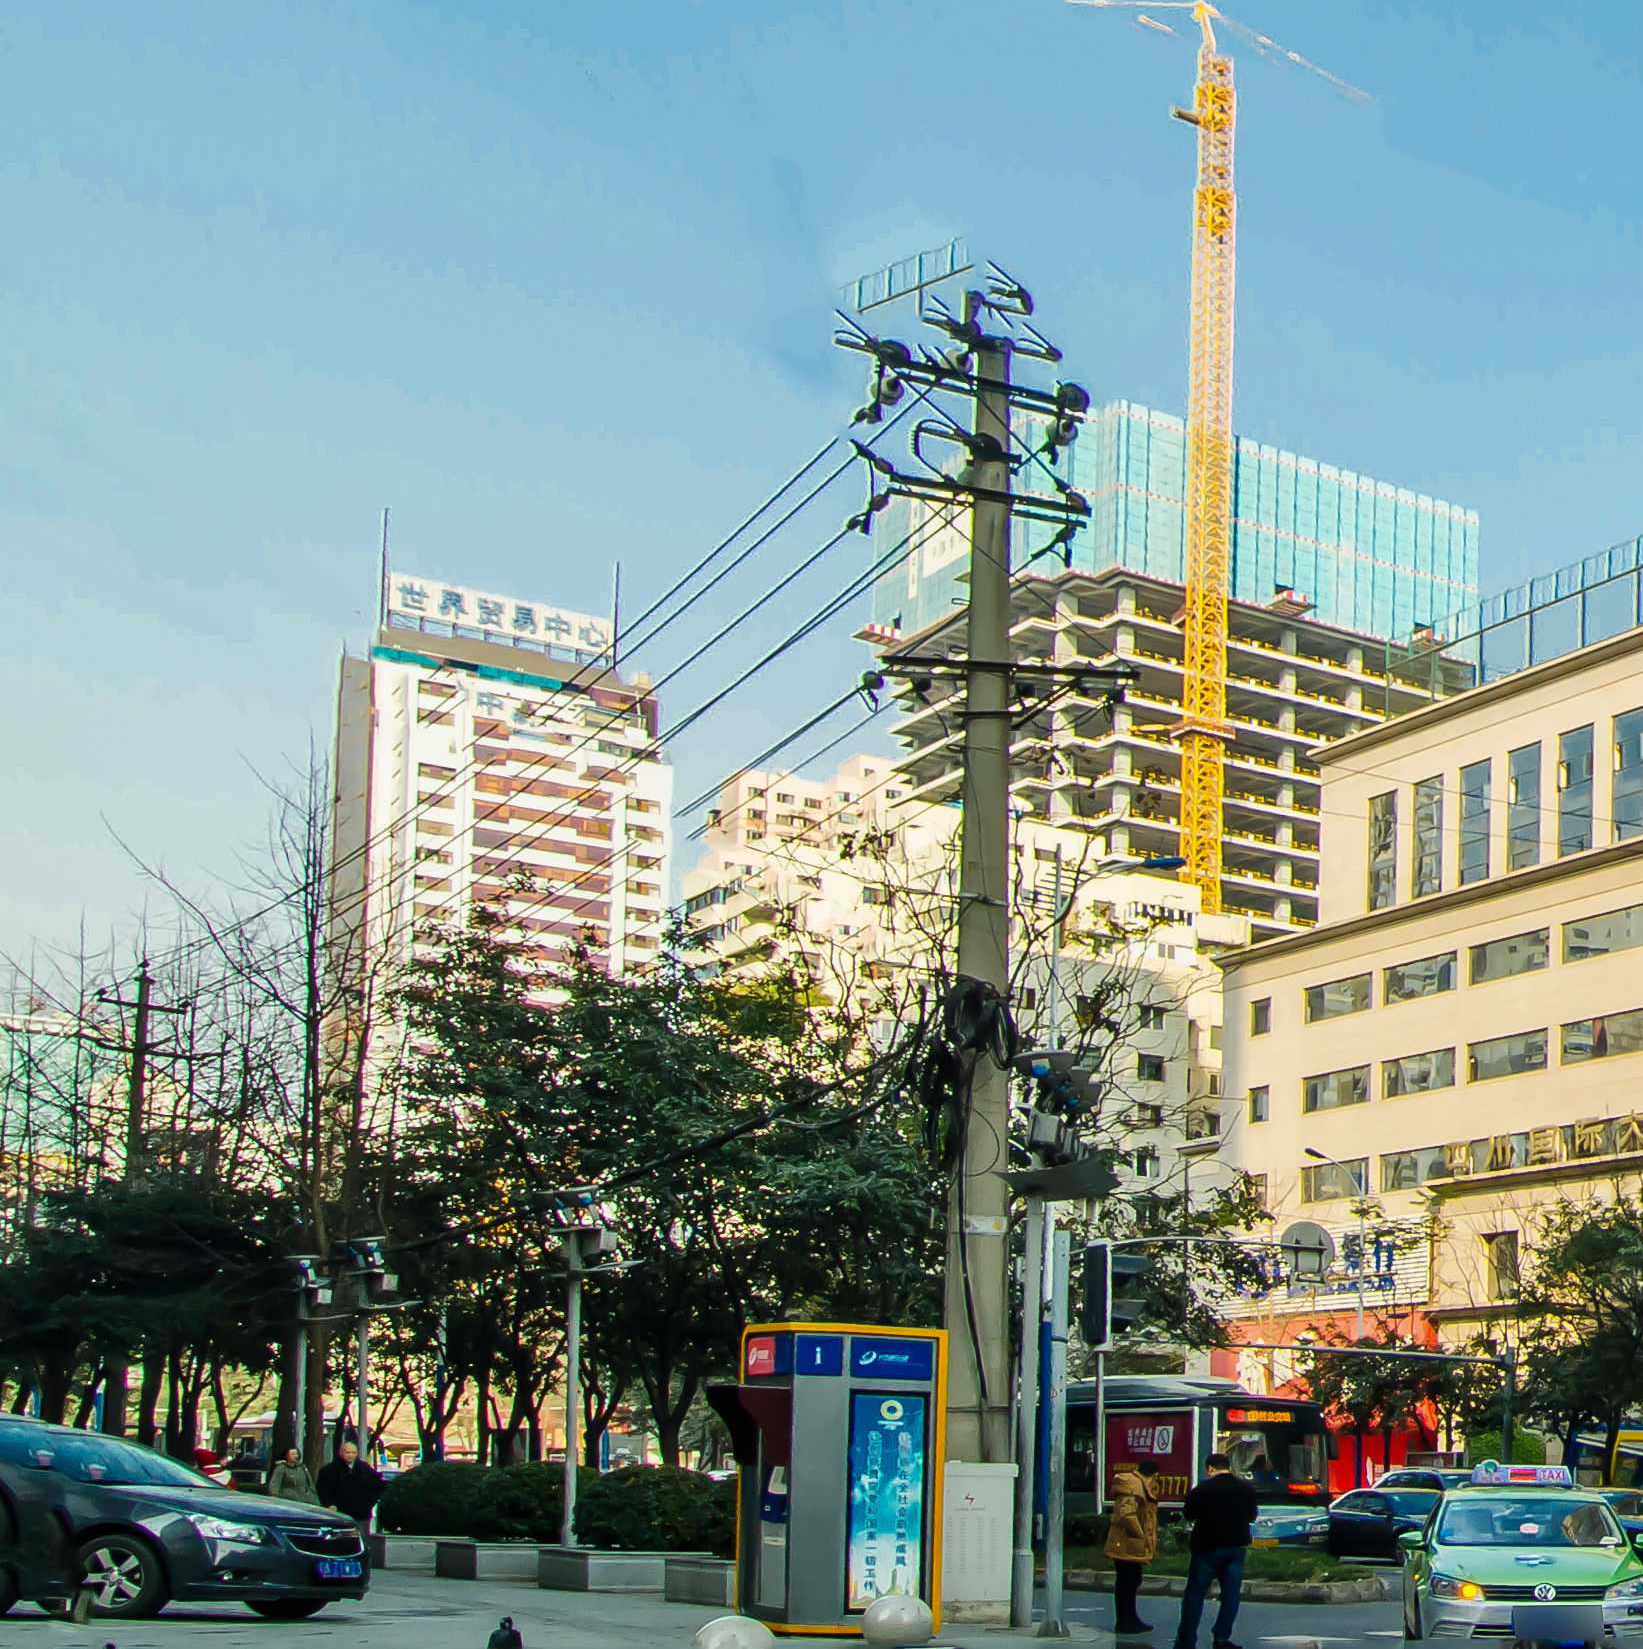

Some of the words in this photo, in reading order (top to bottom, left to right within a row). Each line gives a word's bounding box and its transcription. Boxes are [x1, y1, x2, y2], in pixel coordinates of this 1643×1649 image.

[396, 579, 608, 649] 世界贸易中心
[1540, 1469, 1566, 1481] TAXI
